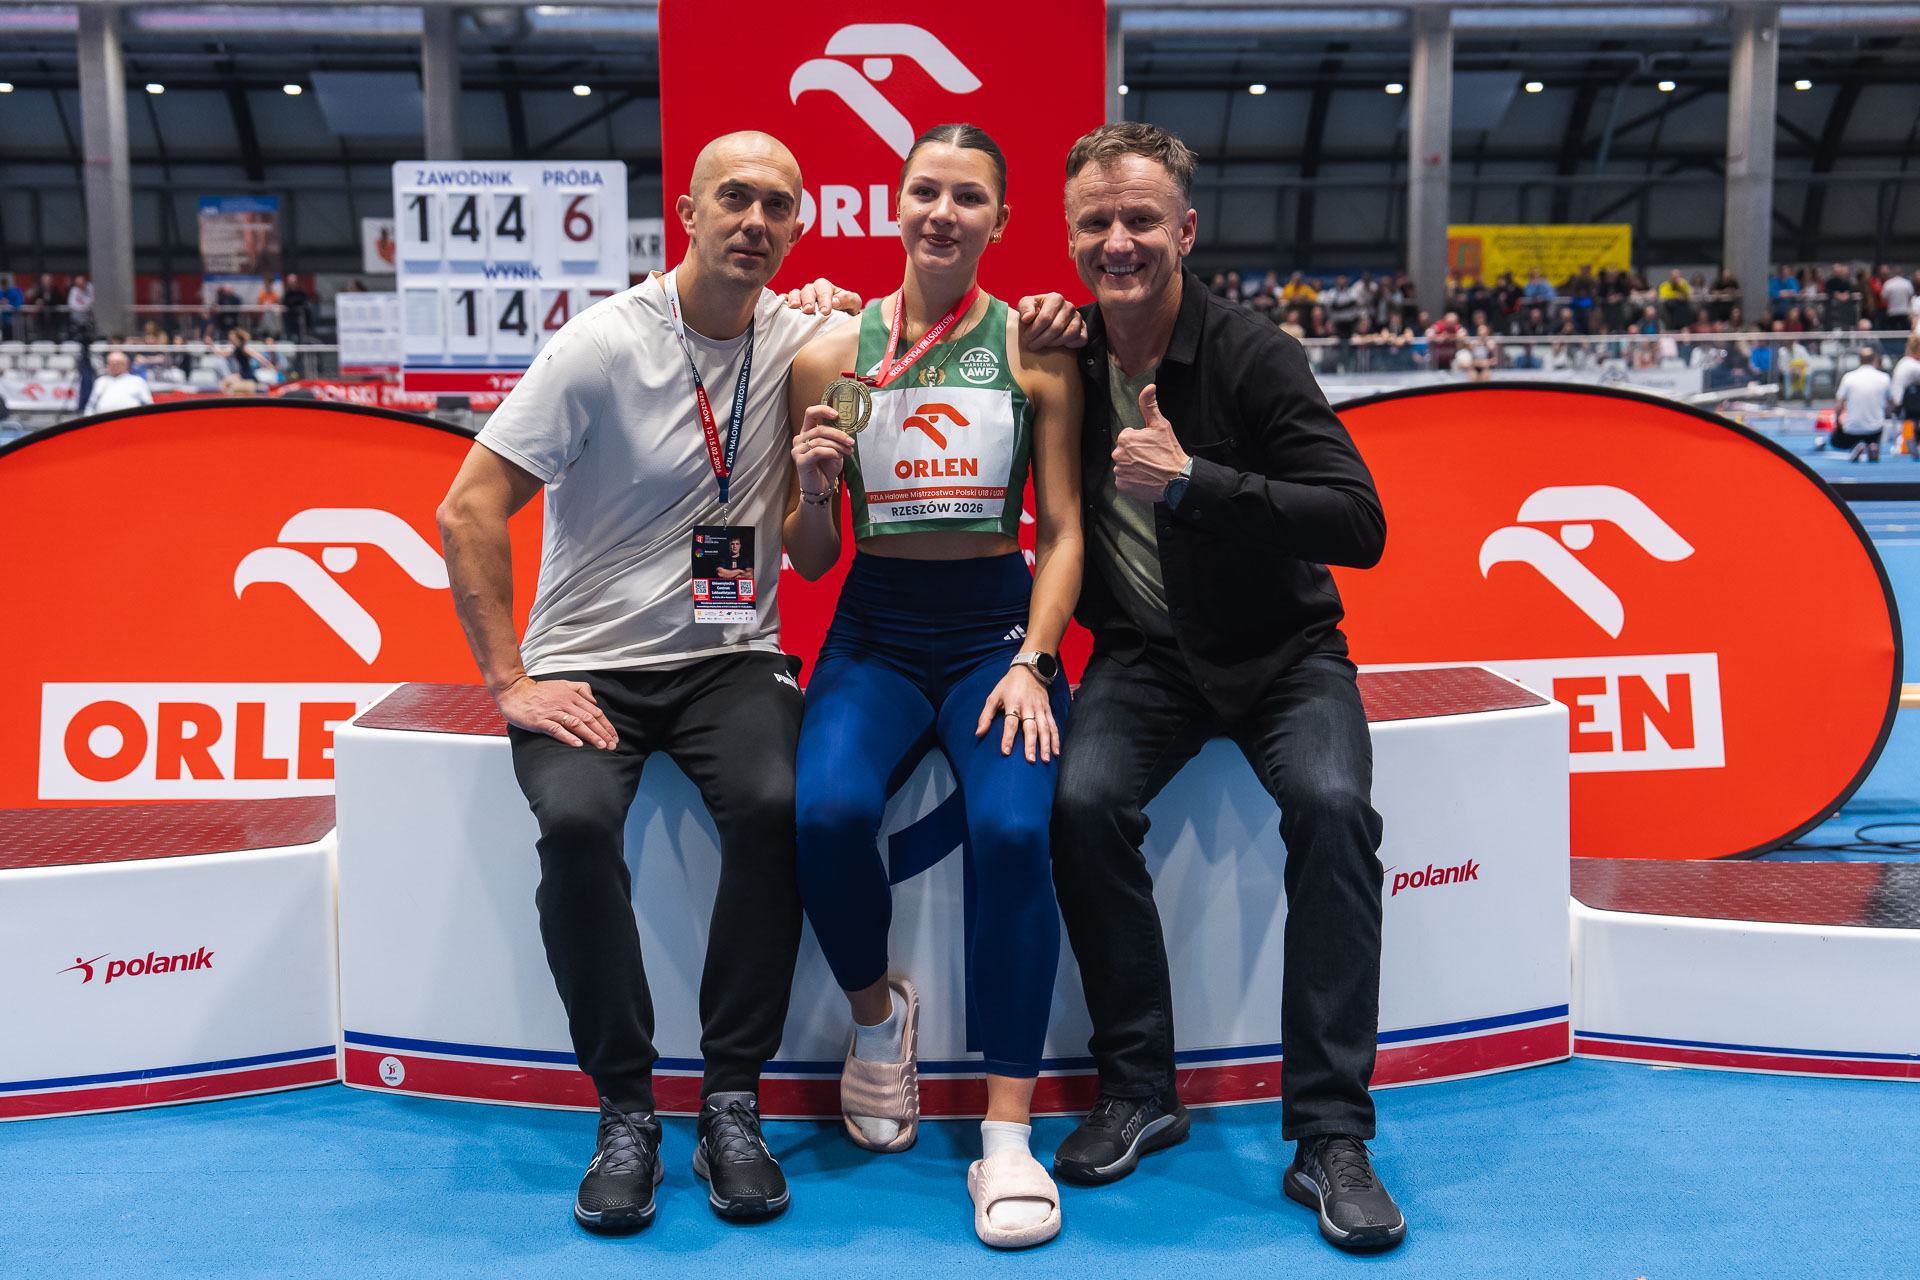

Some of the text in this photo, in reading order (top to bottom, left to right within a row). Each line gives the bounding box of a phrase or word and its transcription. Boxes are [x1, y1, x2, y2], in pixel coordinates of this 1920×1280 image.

[415, 168, 604, 186] ZAWODNIK PRÓBA
[408, 195, 594, 243] 144 6
[628, 233, 661, 256] KR
[481, 264, 543, 280] WYNIK
[918, 312, 955, 350] MISTRZOSTWA
[901, 347, 922, 366] POLSKI
[969, 353, 990, 363] AZS
[967, 368, 992, 377] AWF
[734, 371, 748, 419] MISTRZOSTWA
[729, 420, 740, 450] HALOWE
[894, 458, 978, 479] ORLEN
[870, 494, 884, 502] PZLA
[910, 489, 954, 498] Mistrzostwa
[956, 489, 977, 497] Polski
[891, 501, 983, 517] RZESZÓW 2026
[1552, 672, 1696, 753] EN
[64, 700, 358, 782] ORLE
[1391, 858, 1481, 896] polanik
[105, 946, 215, 984] polanik
